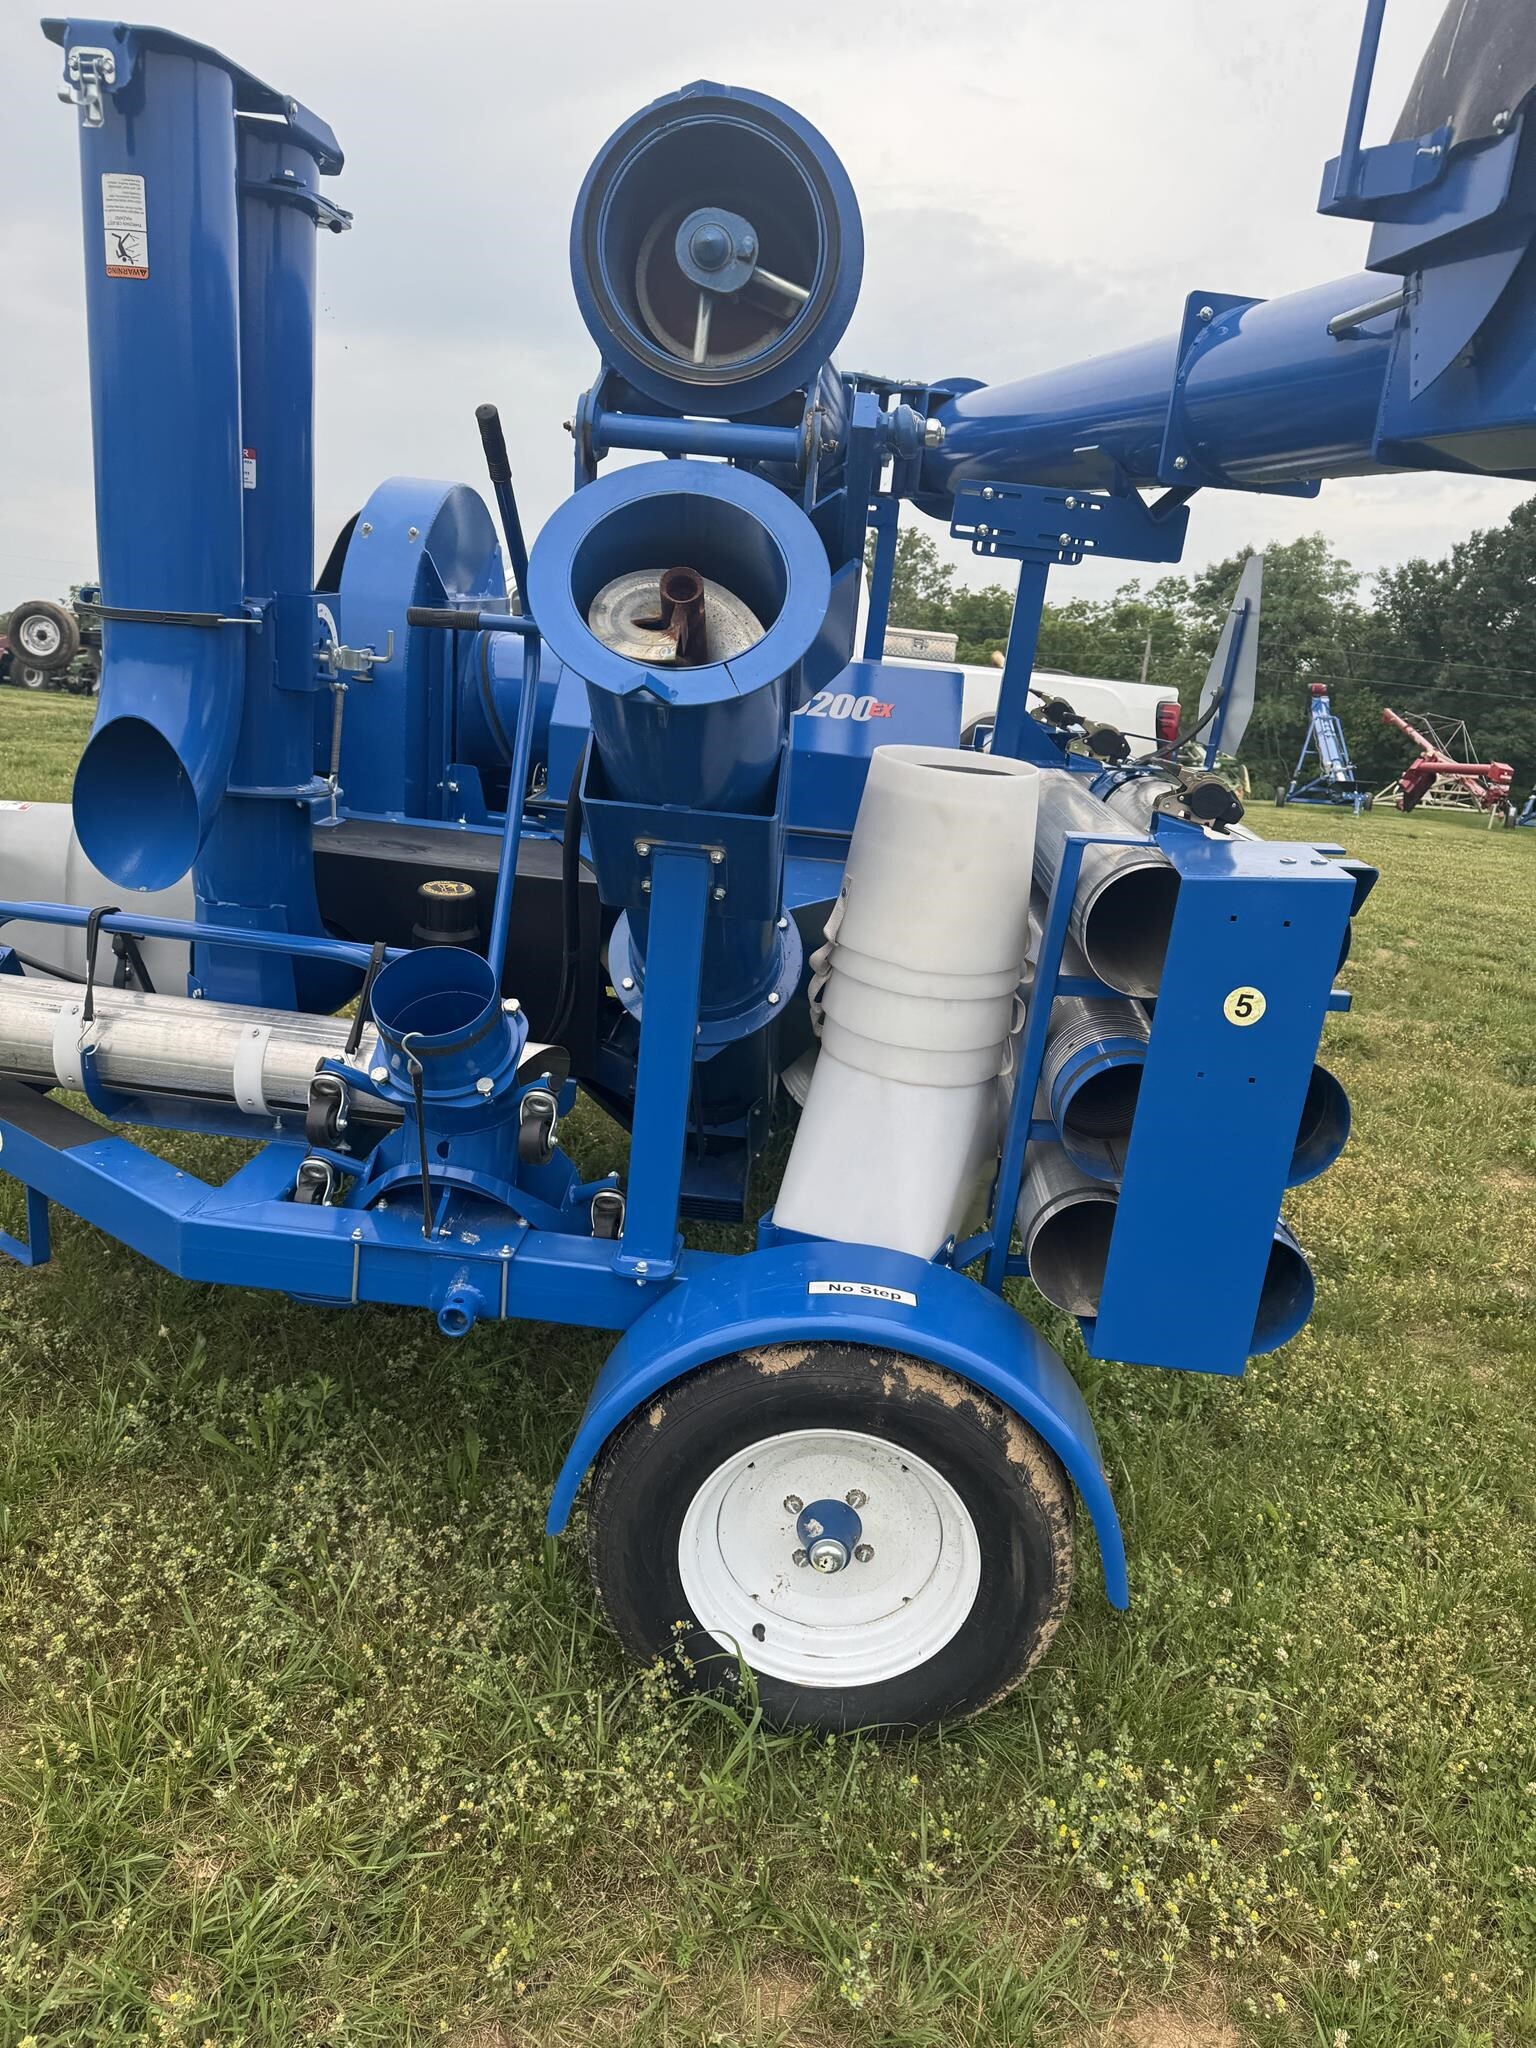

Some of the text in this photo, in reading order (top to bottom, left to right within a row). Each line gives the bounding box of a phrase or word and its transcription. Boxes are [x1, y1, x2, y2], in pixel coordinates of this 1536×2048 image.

[107, 267, 140, 276] WARNING
[1235, 993, 1254, 1018] 5
[828, 1283, 901, 1300] No Step
